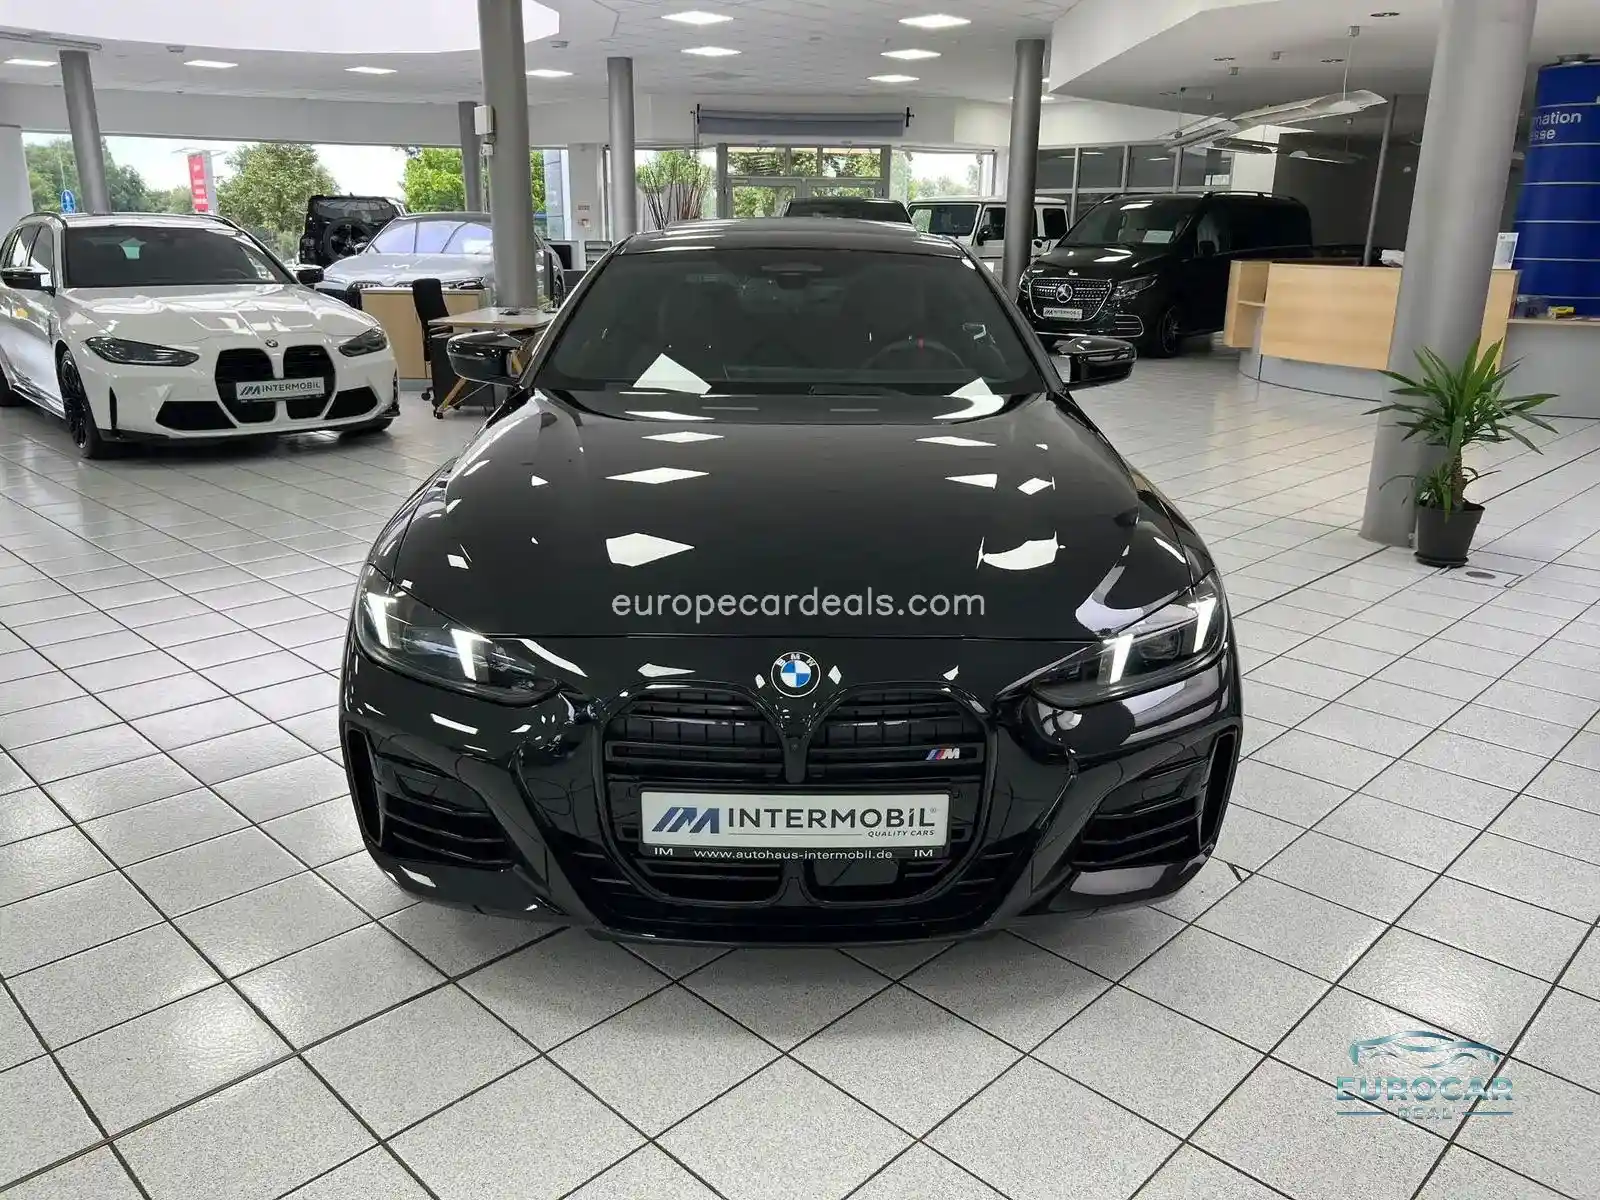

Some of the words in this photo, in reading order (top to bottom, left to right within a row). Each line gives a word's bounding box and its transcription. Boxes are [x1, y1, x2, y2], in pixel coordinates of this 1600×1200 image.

[775, 653, 816, 667] BMW
[867, 830, 908, 838] QUALITY
[910, 829, 935, 837] CARS
[654, 847, 674, 856] IM
[693, 850, 893, 860] www.autohaus-intermobil.de
[914, 849, 934, 858] IM
